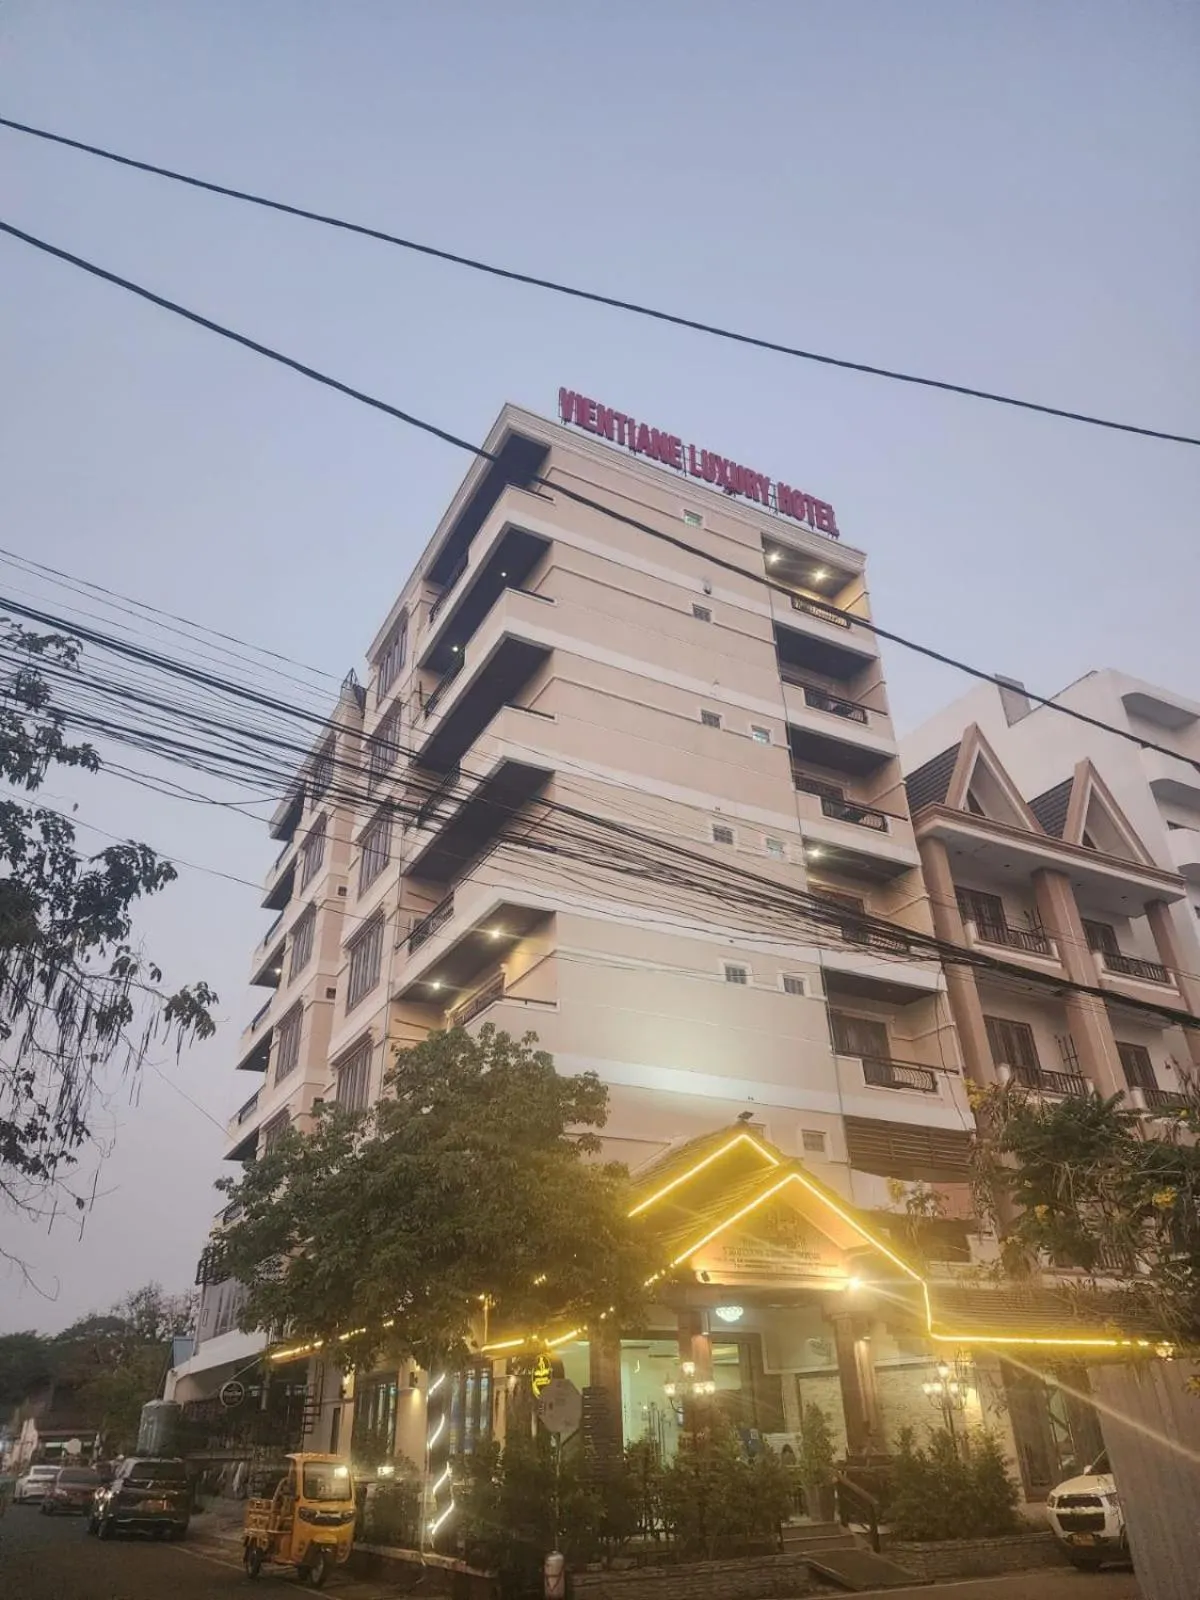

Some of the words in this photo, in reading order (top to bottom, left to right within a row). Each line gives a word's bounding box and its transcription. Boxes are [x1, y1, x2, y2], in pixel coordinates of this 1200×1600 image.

[559, 387, 682, 470] VIENTIANE
[689, 444, 770, 506] LUXURY
[777, 482, 839, 537] HOTEL
